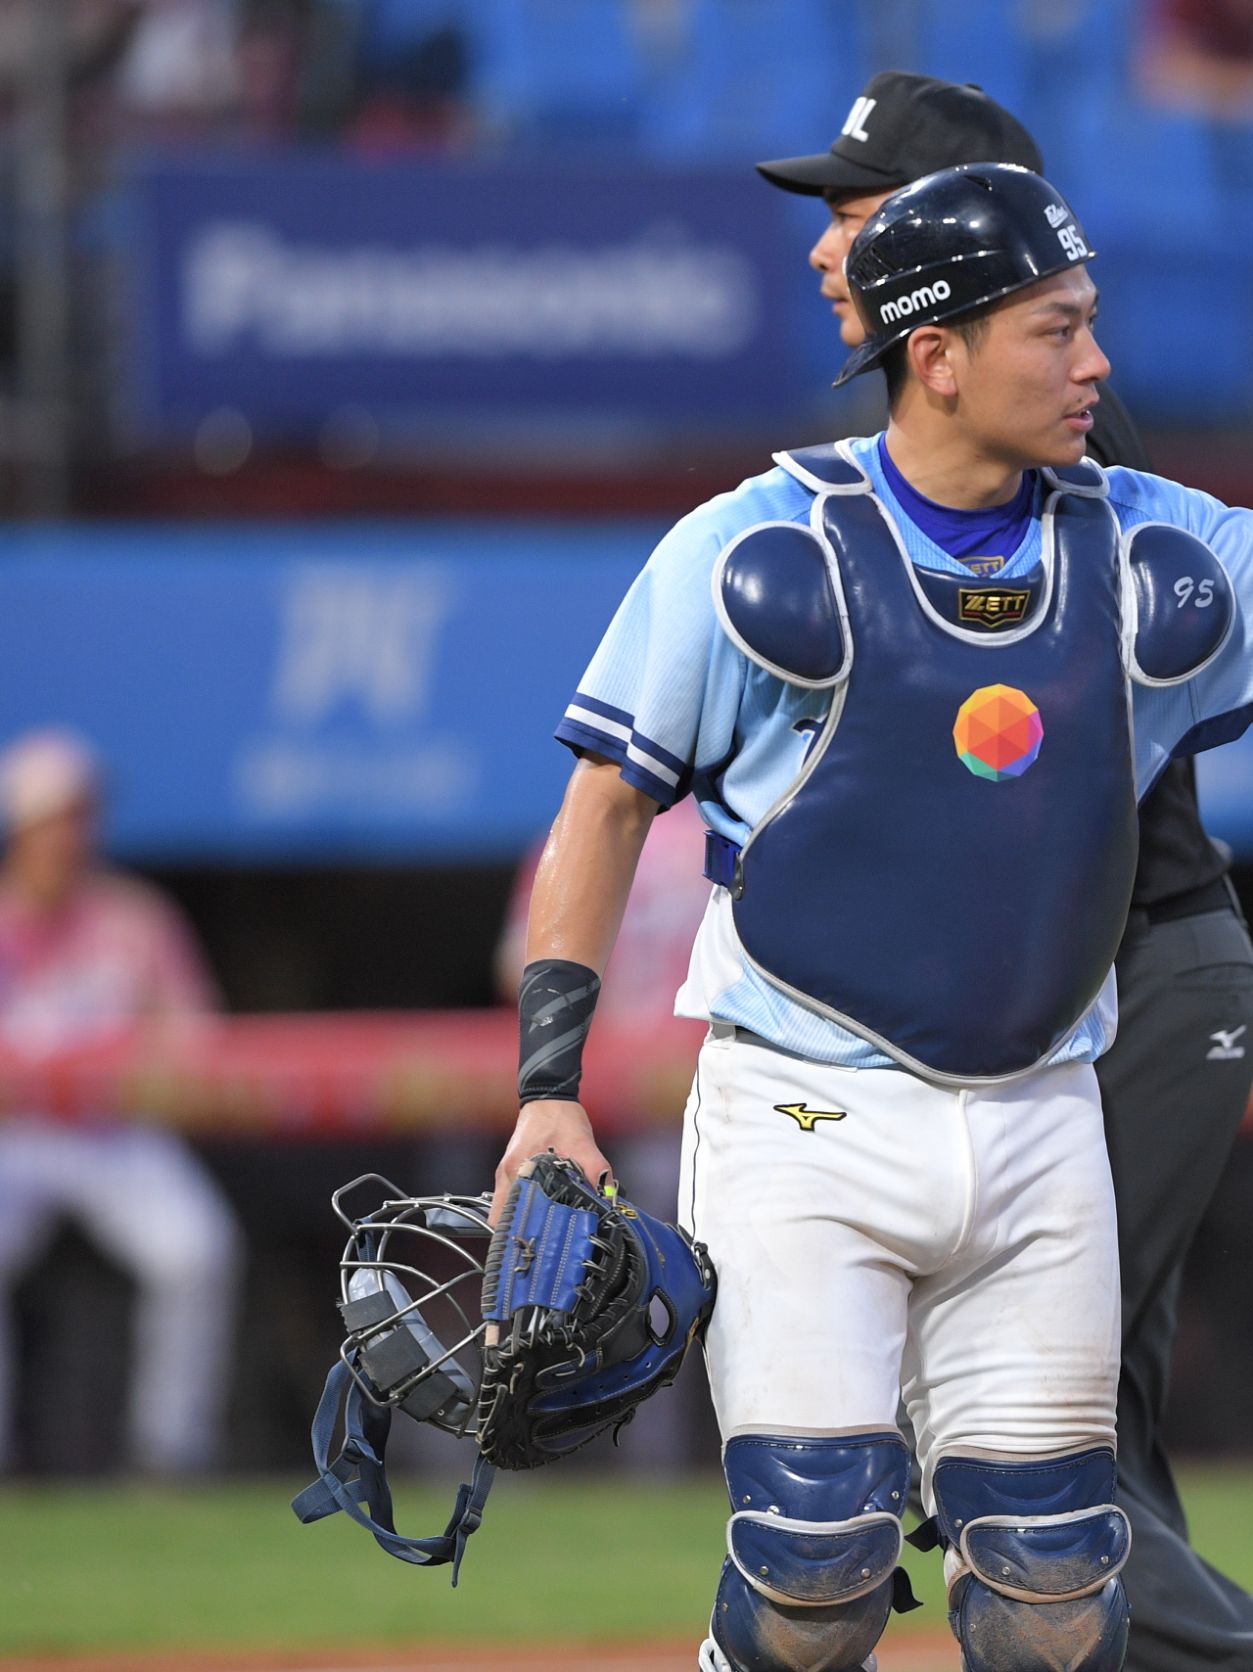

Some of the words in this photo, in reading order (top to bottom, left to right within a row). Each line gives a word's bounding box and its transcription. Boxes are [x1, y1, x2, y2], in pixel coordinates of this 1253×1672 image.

[1057, 224, 1088, 261] 95
[879, 280, 951, 324] momo
[964, 595, 1026, 612] ZETT
[1173, 576, 1214, 608] 95
